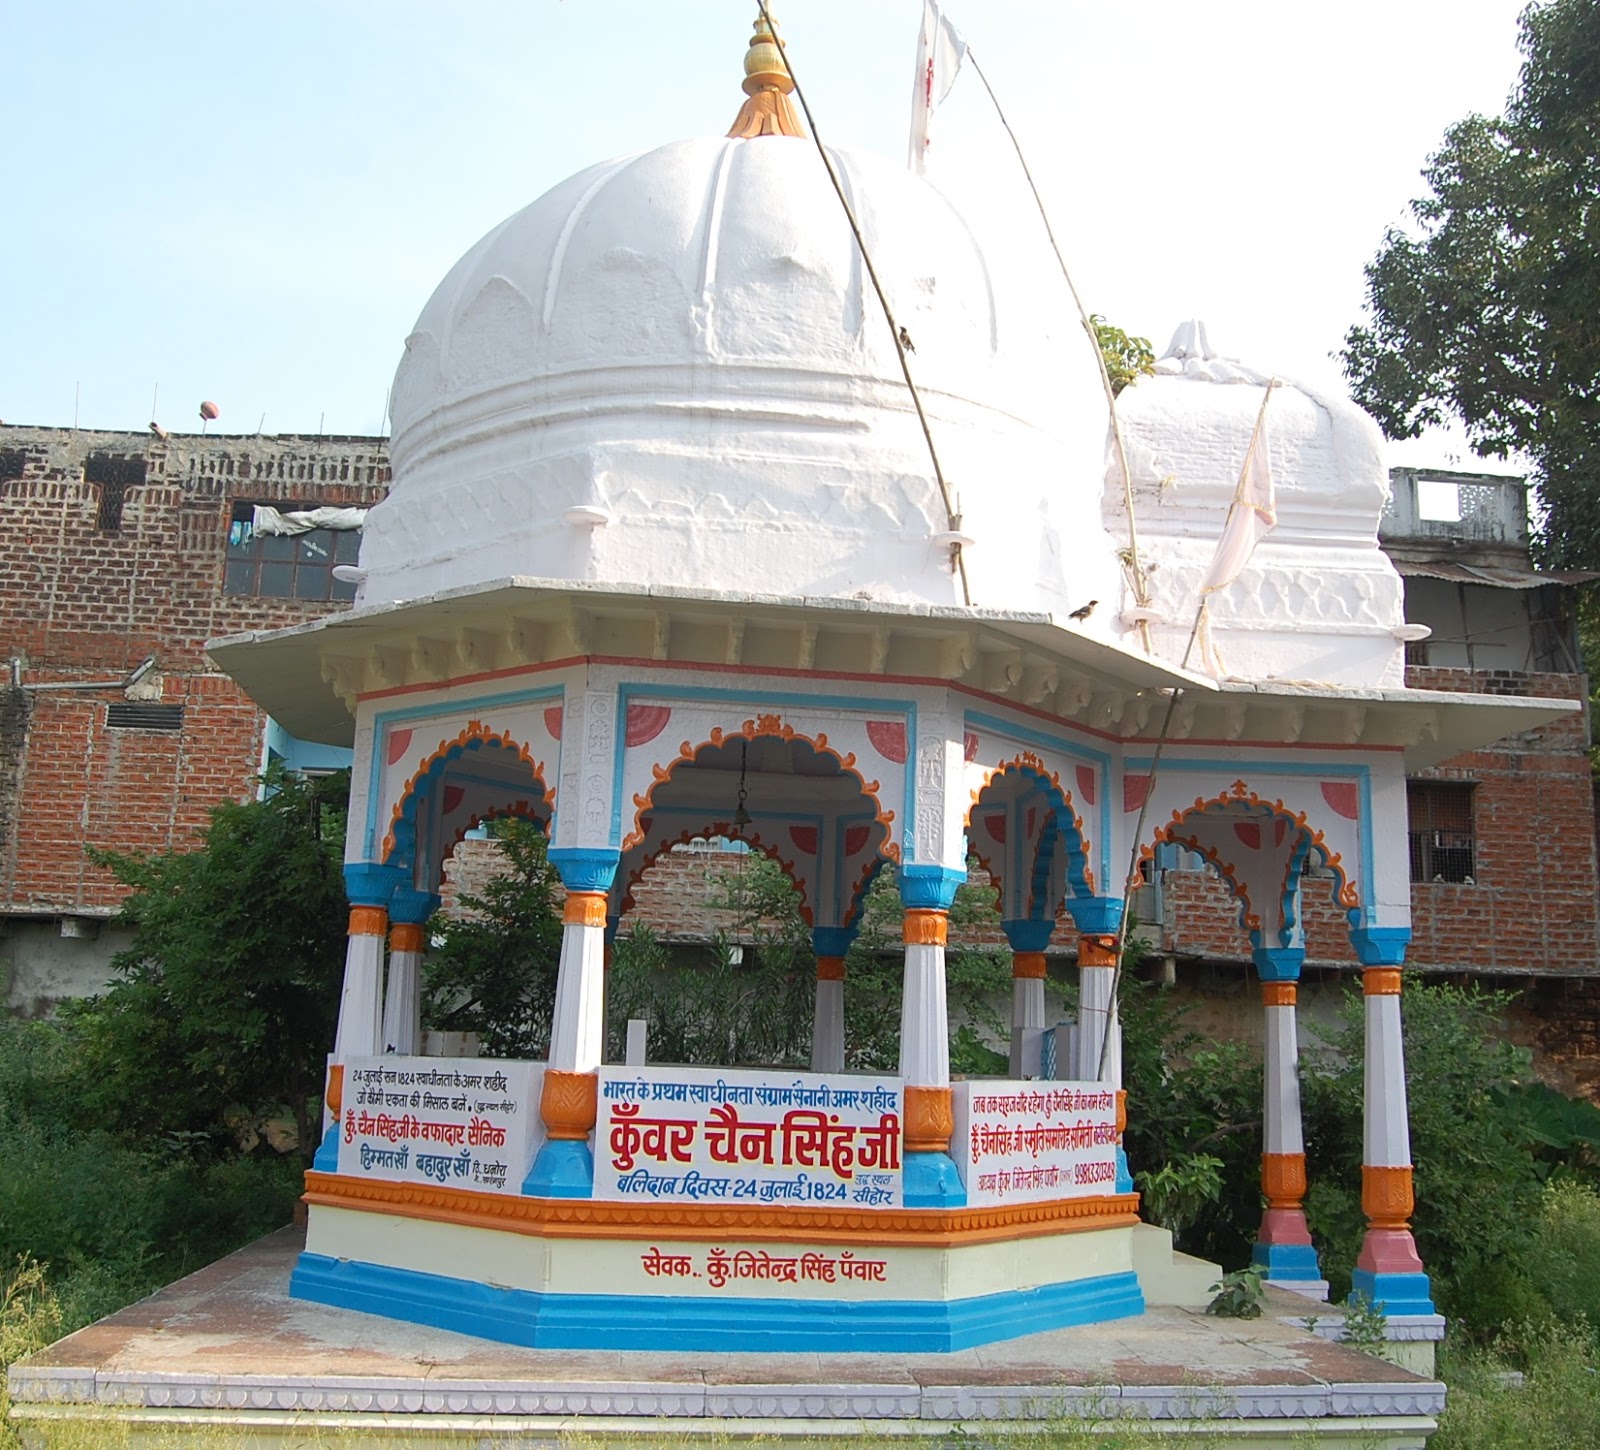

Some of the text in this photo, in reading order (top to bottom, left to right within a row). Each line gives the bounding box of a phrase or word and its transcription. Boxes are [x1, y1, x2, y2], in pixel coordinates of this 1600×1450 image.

[362, 1066, 383, 1087] जुलाई
[398, 1072, 416, 1085] 1824
[416, 1068, 453, 1086] स्वाधीनता
[454, 1070, 462, 1087] के
[462, 1074, 482, 1089] अमर
[483, 1070, 508, 1093] शहीद
[604, 1081, 637, 1104] भारत
[637, 1076, 650, 1100] के
[651, 1083, 688, 1102] प्रथम
[689, 1079, 754, 1105] स्वाधीनता
[755, 1082, 792, 1106] संग्राम
[831, 1090, 860, 1111] अमर
[860, 1086, 899, 1114] शहीद
[356, 1087, 368, 1105] जो
[385, 1093, 408, 1108] एकता
[410, 1090, 421, 1108] की
[422, 1092, 449, 1110] मिसाल
[973, 1096, 986, 1114] जब
[987, 1096, 997, 1114] तक
[358, 1110, 376, 1136] चैन
[410, 1115, 420, 1140] के
[468, 1116, 506, 1148] सैनिक
[609, 1104, 698, 1171] कुँवर
[704, 1102, 776, 1164] चैन
[858, 1114, 900, 1169] जी
[416, 1154, 453, 1182] बहादुर
[453, 1148, 471, 1178] खाँ
[617, 1169, 678, 1198] बलिदान
[760, 1173, 807, 1202] जुलाई
[807, 1182, 847, 1201] 1824
[852, 1186, 894, 1206] सीहोर
[733, 1250, 798, 1283] जितेन्द्र
[800, 1252, 836, 1283] सिंह
[838, 1250, 887, 1282] पँवार
